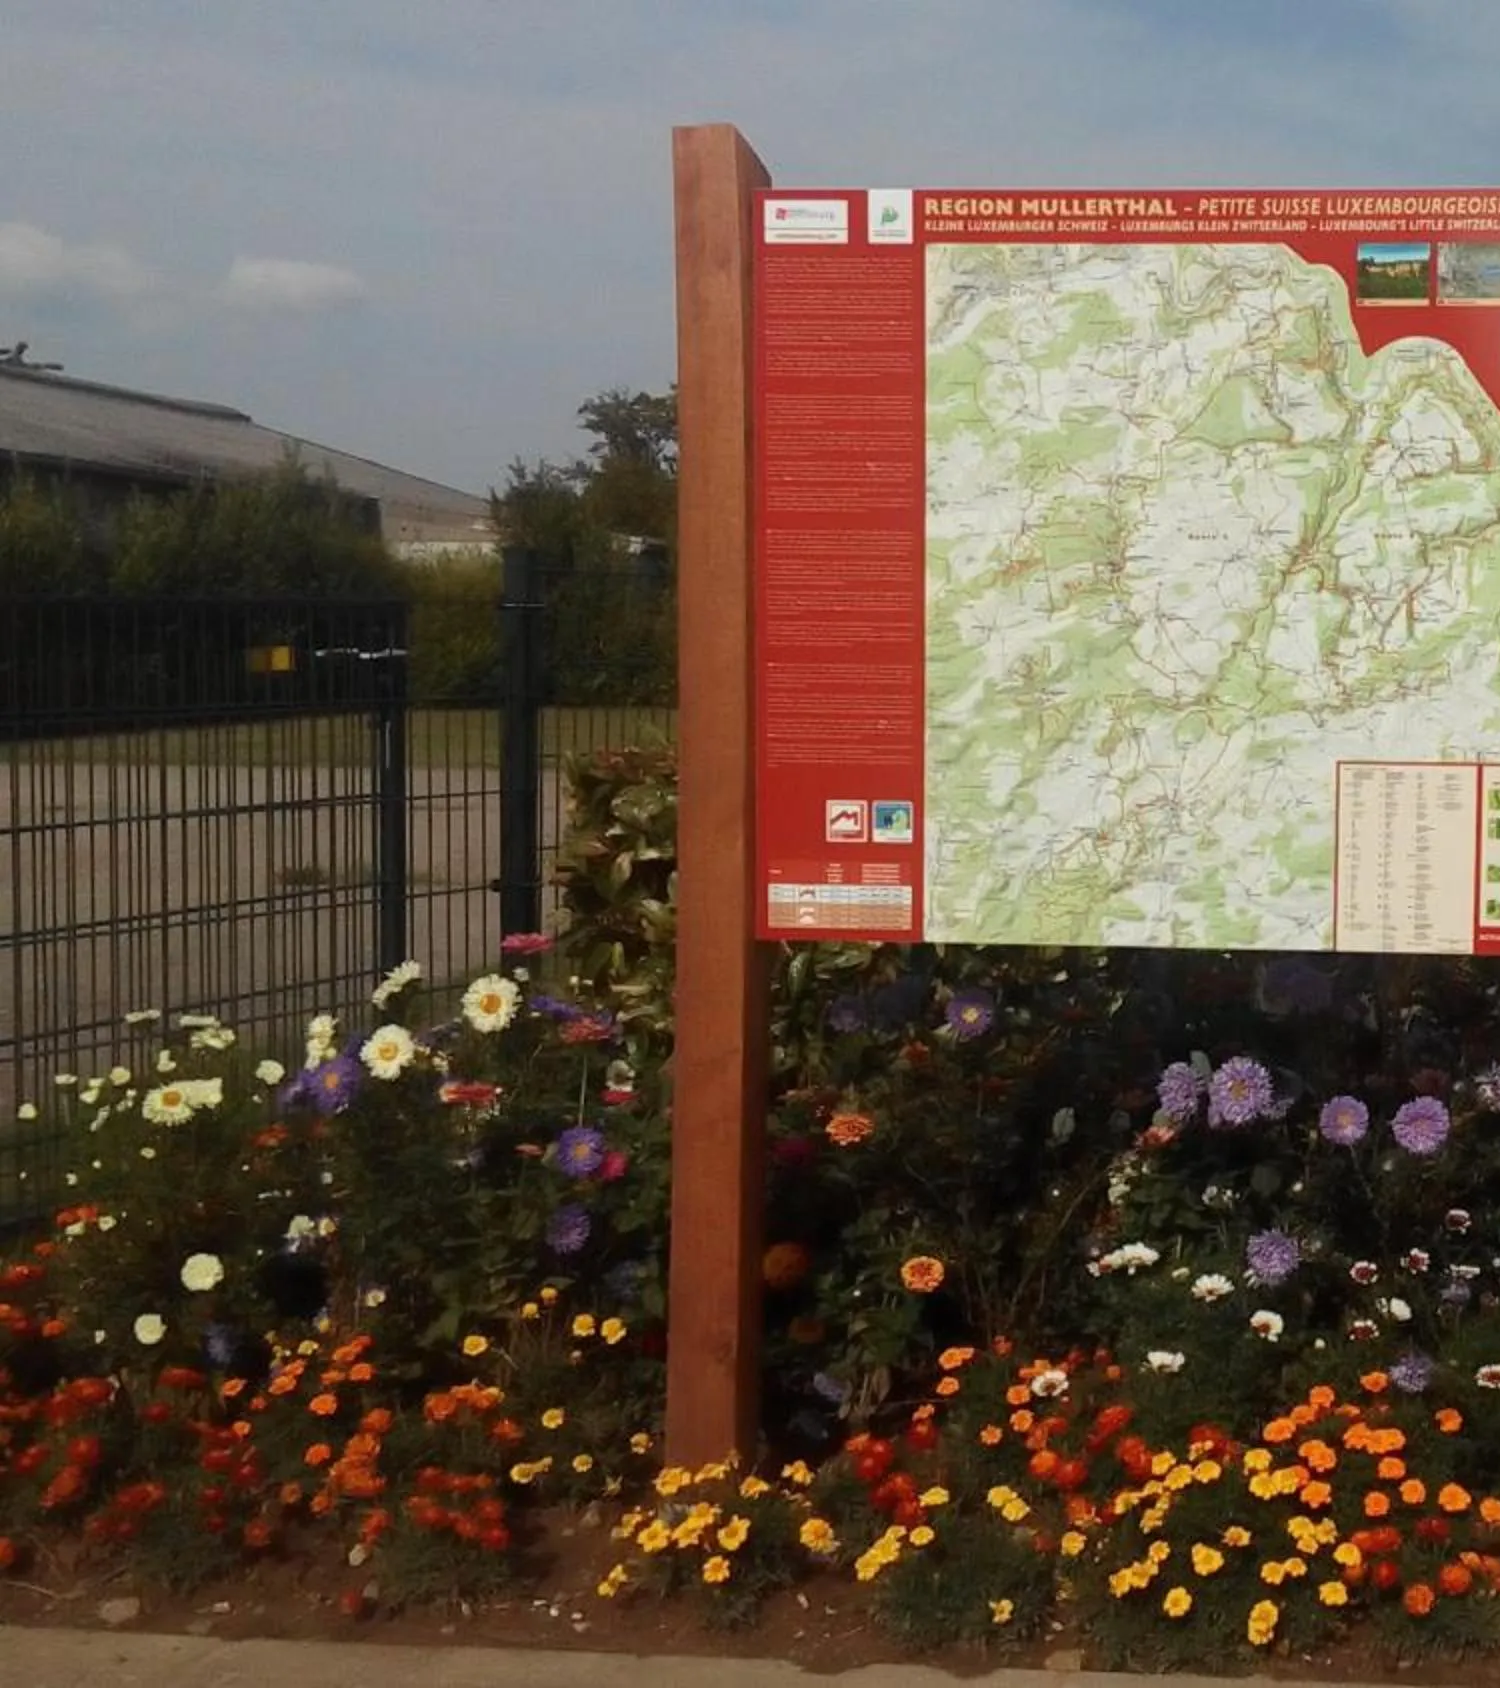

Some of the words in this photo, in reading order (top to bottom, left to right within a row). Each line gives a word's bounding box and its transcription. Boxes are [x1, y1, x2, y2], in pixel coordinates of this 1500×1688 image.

[924, 197, 1014, 216] REGION
[1021, 197, 1177, 216] MULLERTHAL
[1198, 197, 1257, 216] PETITE
[1262, 196, 1321, 215] SUISSE
[1057, 219, 1109, 232] SCHWEIZ
[1197, 219, 1230, 232] KLEIN
[1409, 218, 1444, 231] LITTLE
